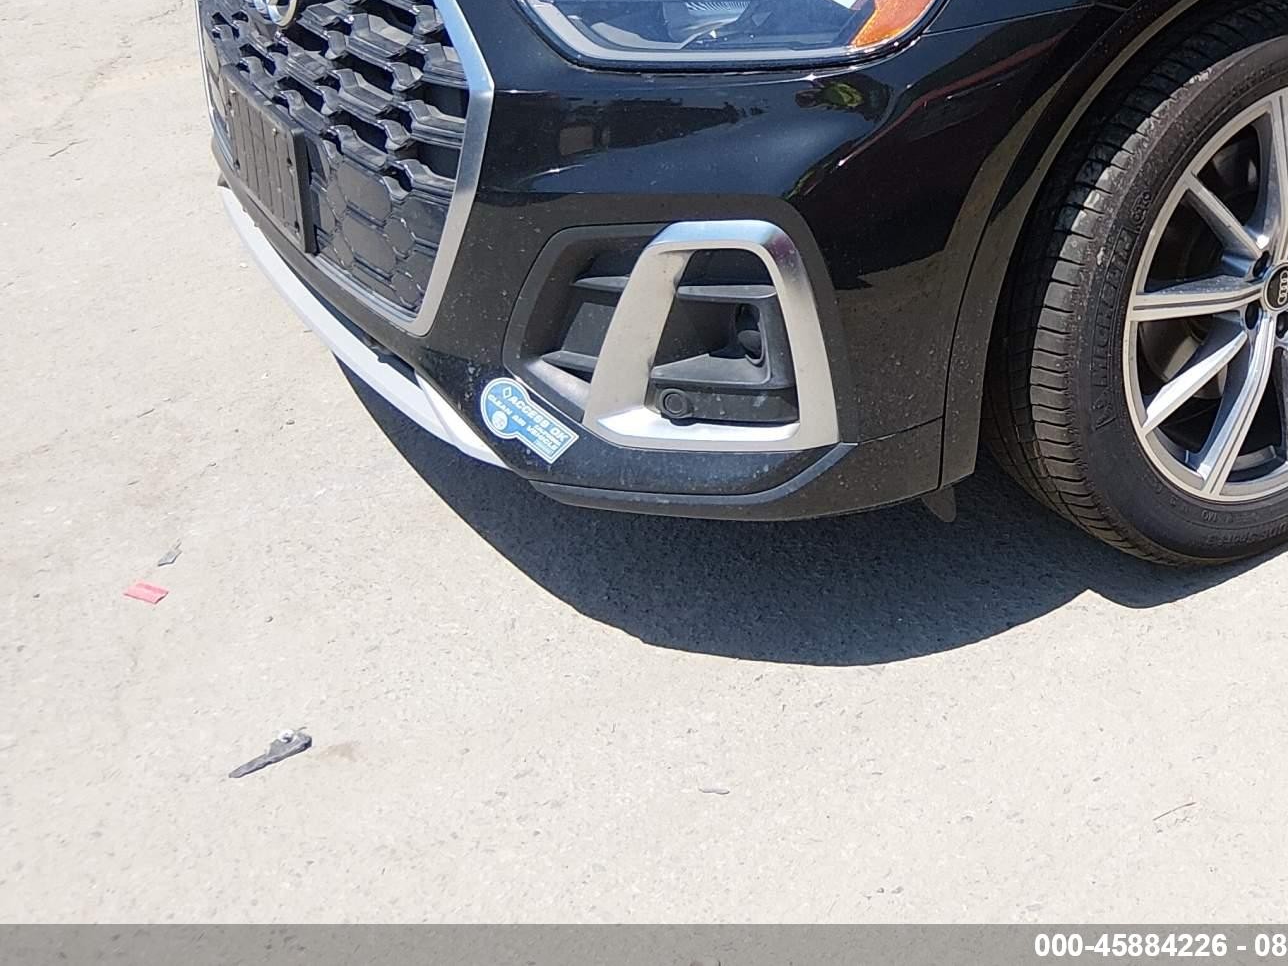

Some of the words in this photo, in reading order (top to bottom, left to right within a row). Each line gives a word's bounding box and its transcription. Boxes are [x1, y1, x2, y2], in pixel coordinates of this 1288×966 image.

[487, 394, 513, 415] CLEAN
[511, 414, 527, 427] AIR
[526, 425, 558, 450] VEHICLE
[507, 395, 550, 428] ACCESS
[550, 427, 569, 442] OK
